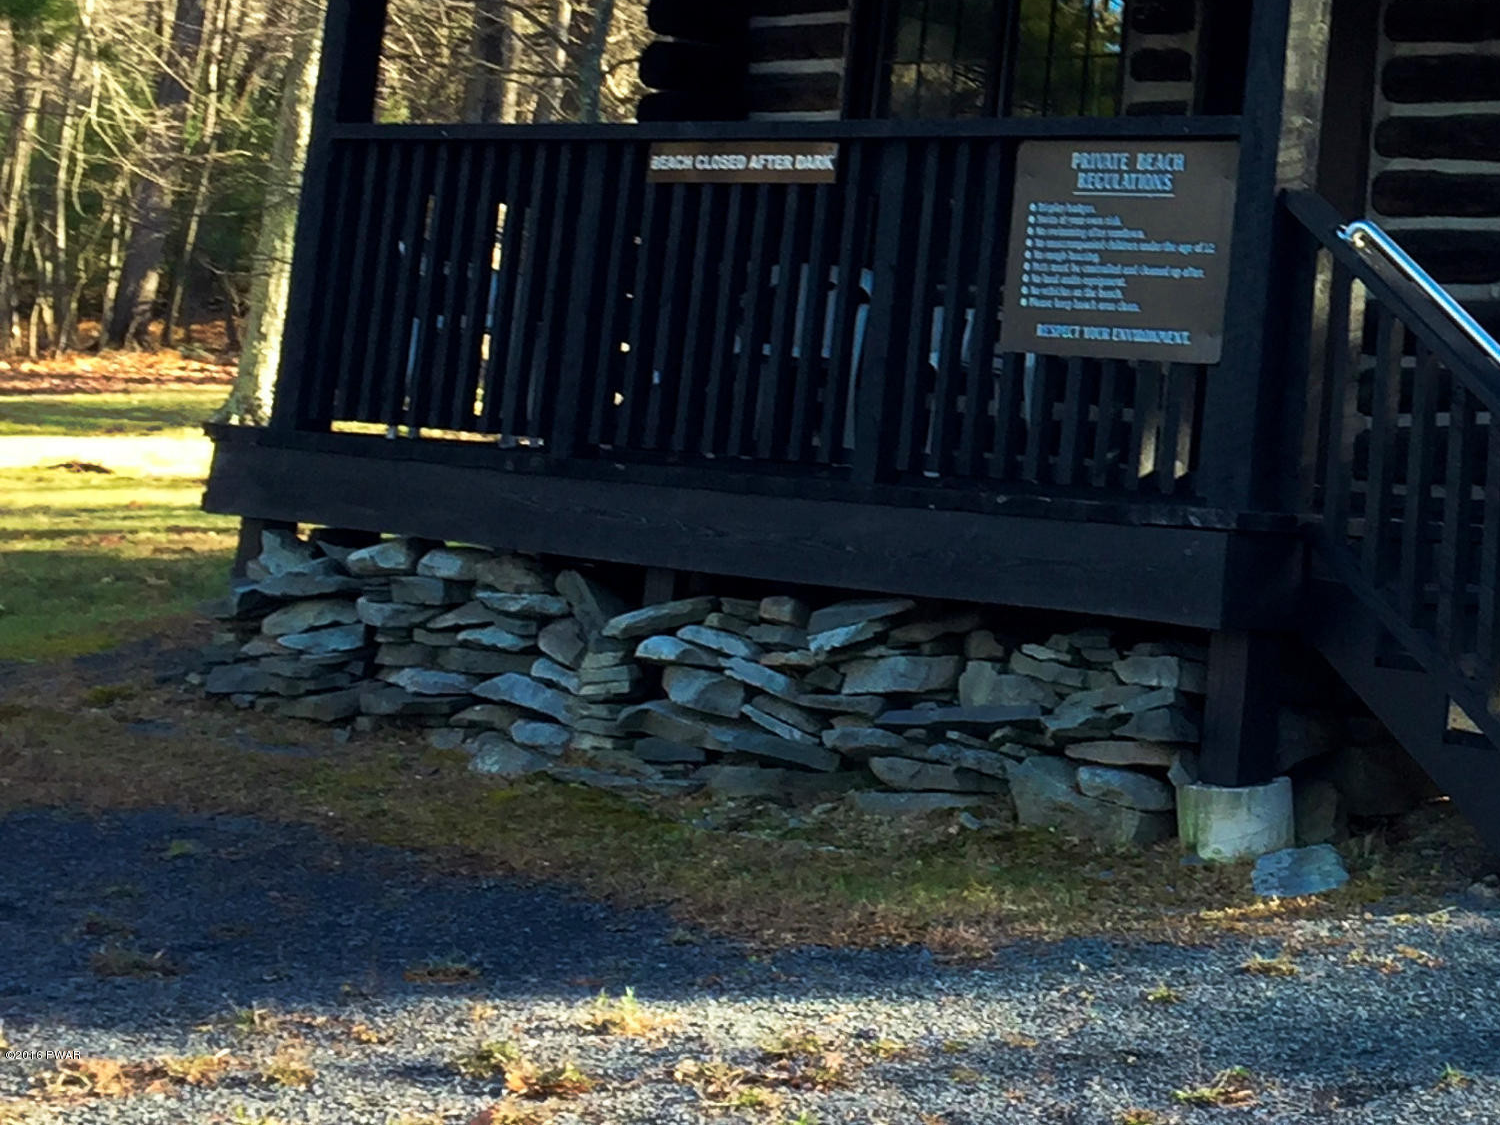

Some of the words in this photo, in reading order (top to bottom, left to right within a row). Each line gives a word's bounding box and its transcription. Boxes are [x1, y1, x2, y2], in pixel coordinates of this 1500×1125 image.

[650, 155, 694, 170] BEACH
[695, 155, 748, 170] CLOSED
[748, 155, 794, 170] AFTER
[794, 155, 835, 170] DARK
[1071, 152, 1130, 170] PRIVATE
[1136, 152, 1185, 171] BEACH
[1077, 172, 1173, 191] REGULATIONS
